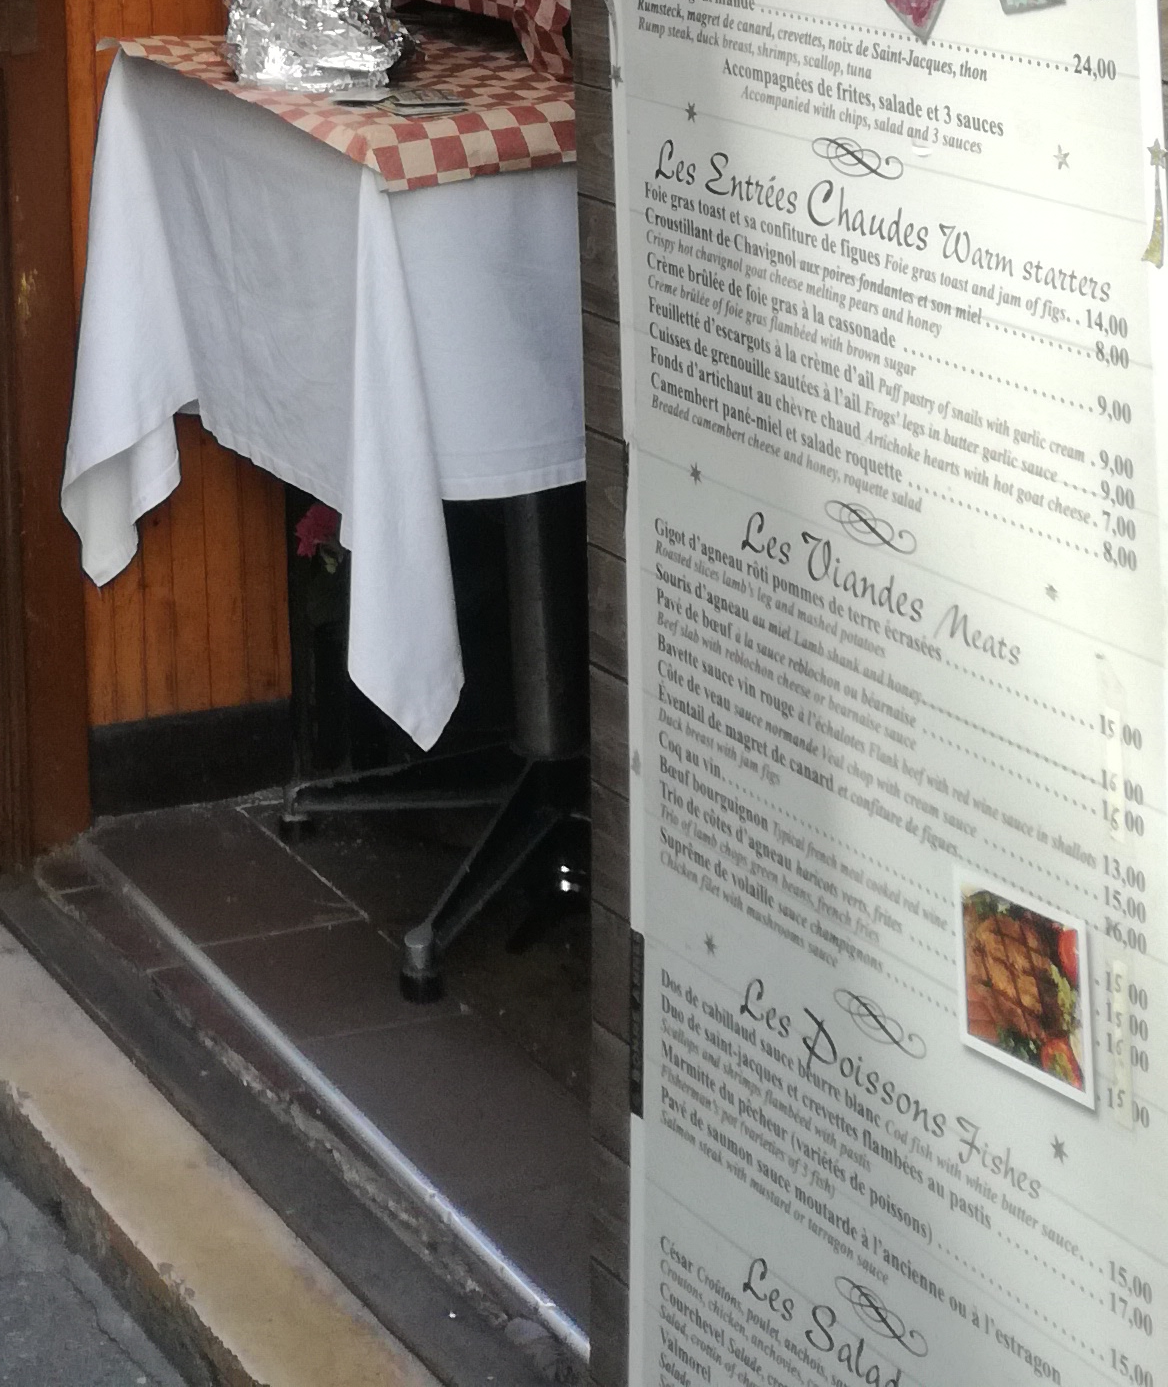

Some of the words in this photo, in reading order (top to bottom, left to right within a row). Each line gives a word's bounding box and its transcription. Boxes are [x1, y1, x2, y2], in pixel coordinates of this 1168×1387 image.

[1073, 54, 1117, 81] 24,00
[655, 139, 697, 186] Les
[705, 151, 799, 216] Entrées
[807, 179, 929, 252] Chaudes
[939, 221, 1015, 279] Warm
[1022, 258, 1112, 304] starters
[1085, 306, 1129, 339] 14,00
[741, 510, 792, 565] Les
[801, 530, 925, 624] Viandes
[933, 603, 1023, 667] Meats
[739, 977, 792, 1039] Les
[801, 1006, 948, 1140] Poissons
[956, 1115, 1044, 1201] Fishes
[743, 1258, 794, 1321] Les
